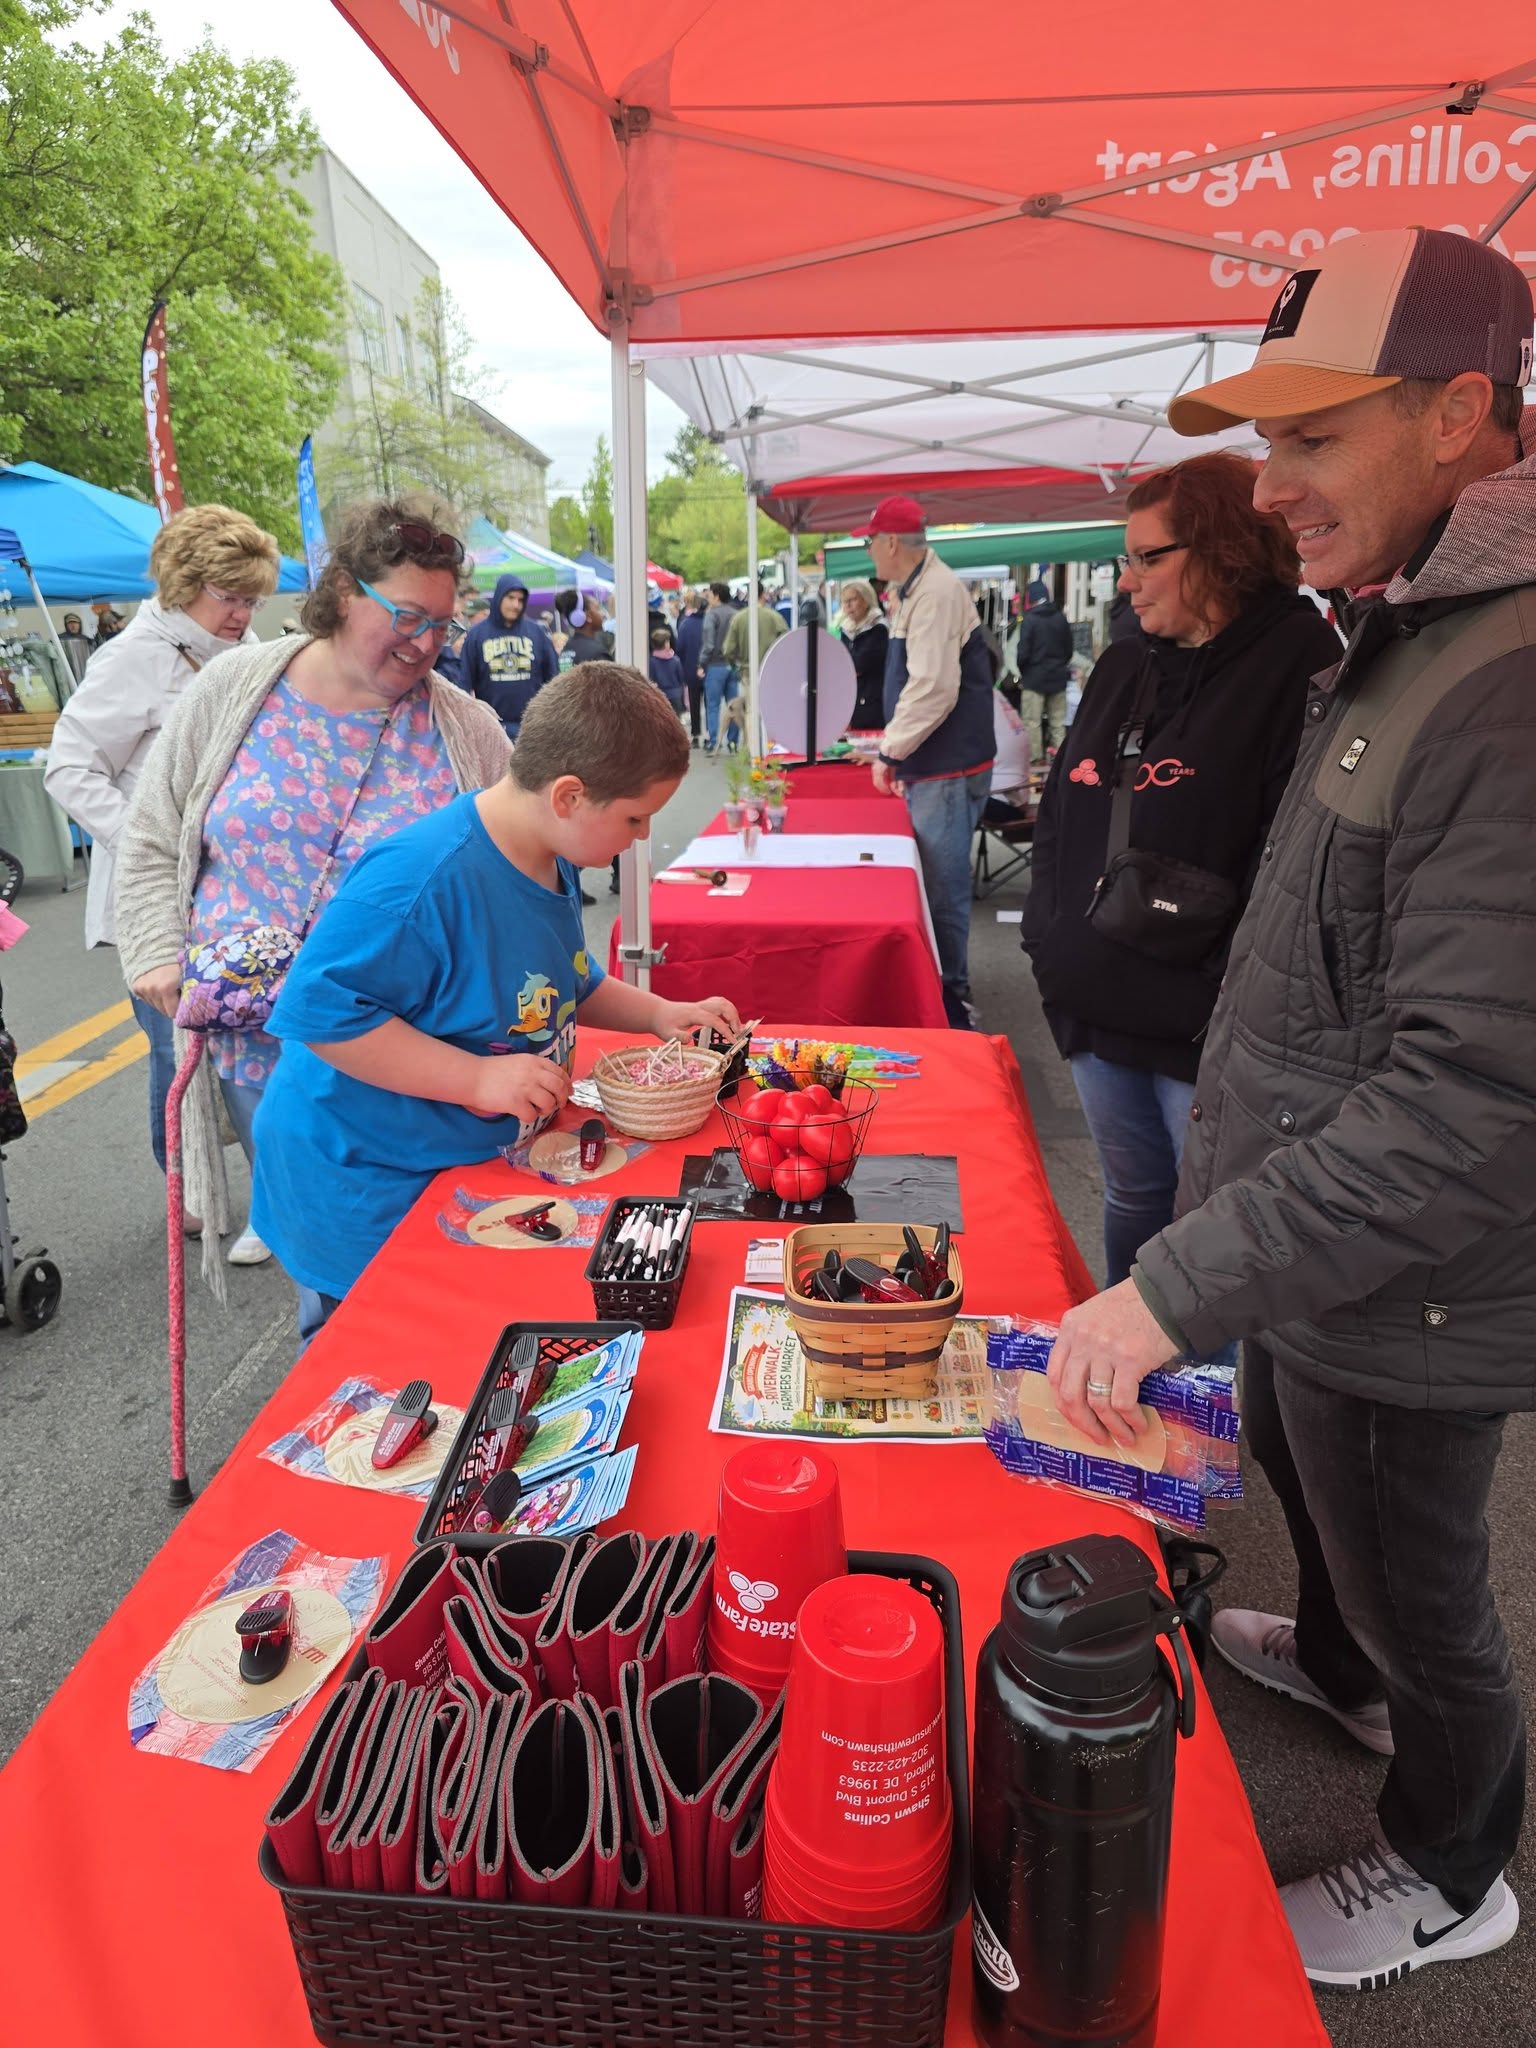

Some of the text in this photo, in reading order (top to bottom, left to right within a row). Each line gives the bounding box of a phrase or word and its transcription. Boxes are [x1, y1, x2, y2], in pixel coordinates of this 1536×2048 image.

[1168, 768, 1196, 776] YEARS
[763, 1345, 782, 1400] RIVERWALK
[780, 1335, 797, 1411] FARMERS MARKET
[1087, 1484, 1132, 1499] Jar Opener
[414, 1647, 434, 1671] Shawn
[839, 1754, 935, 1790] Milford, DE 19963
[852, 1743, 929, 1773] 302-422-2235
[835, 1770, 936, 1807] 915 S Dupont Blvd
[844, 1794, 930, 1826] Shawn Collins
